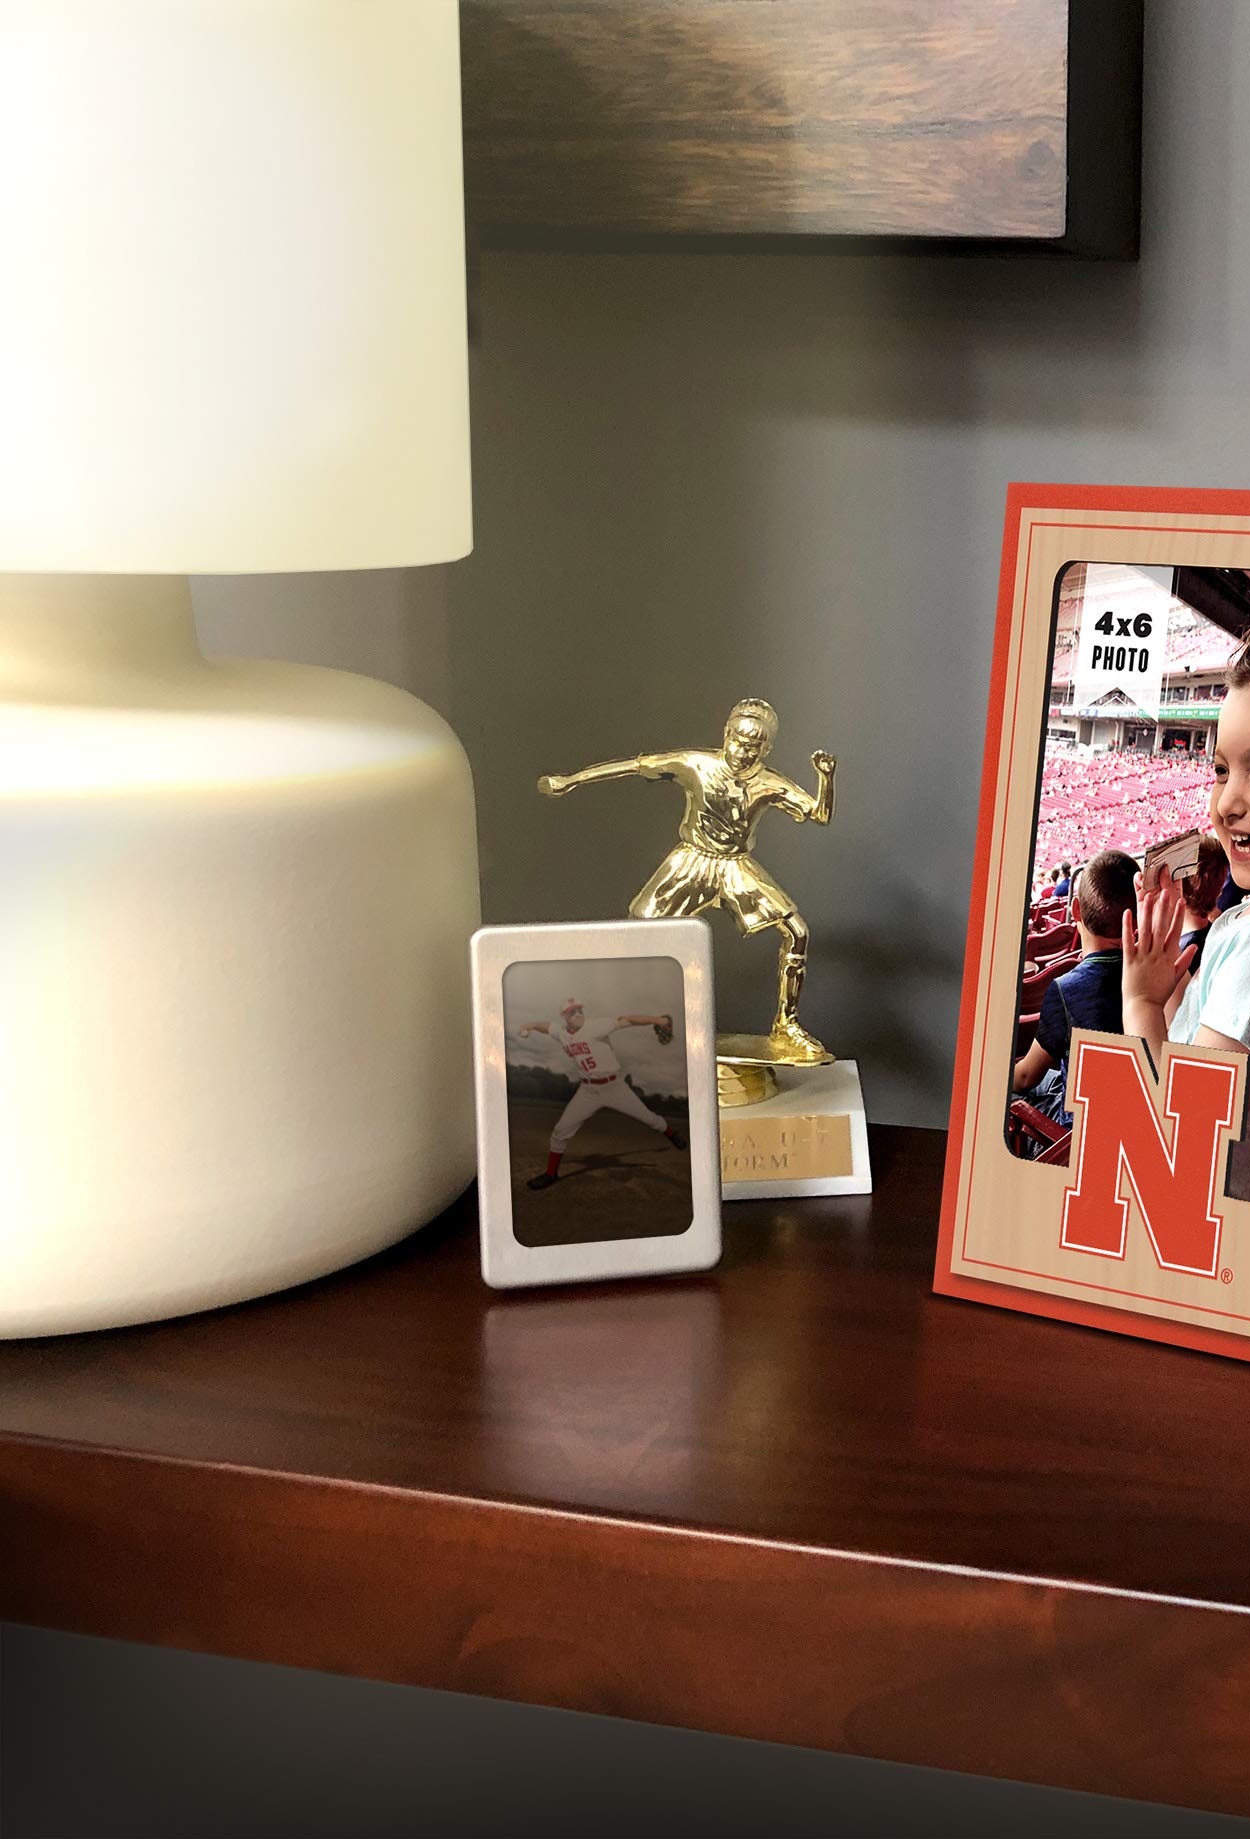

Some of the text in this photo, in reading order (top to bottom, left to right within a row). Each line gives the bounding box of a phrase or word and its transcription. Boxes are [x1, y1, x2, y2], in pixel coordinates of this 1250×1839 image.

[1094, 611, 1153, 638] 4x6
[1091, 645, 1149, 673] PHOTO
[1058, 1039, 1239, 1281] N
